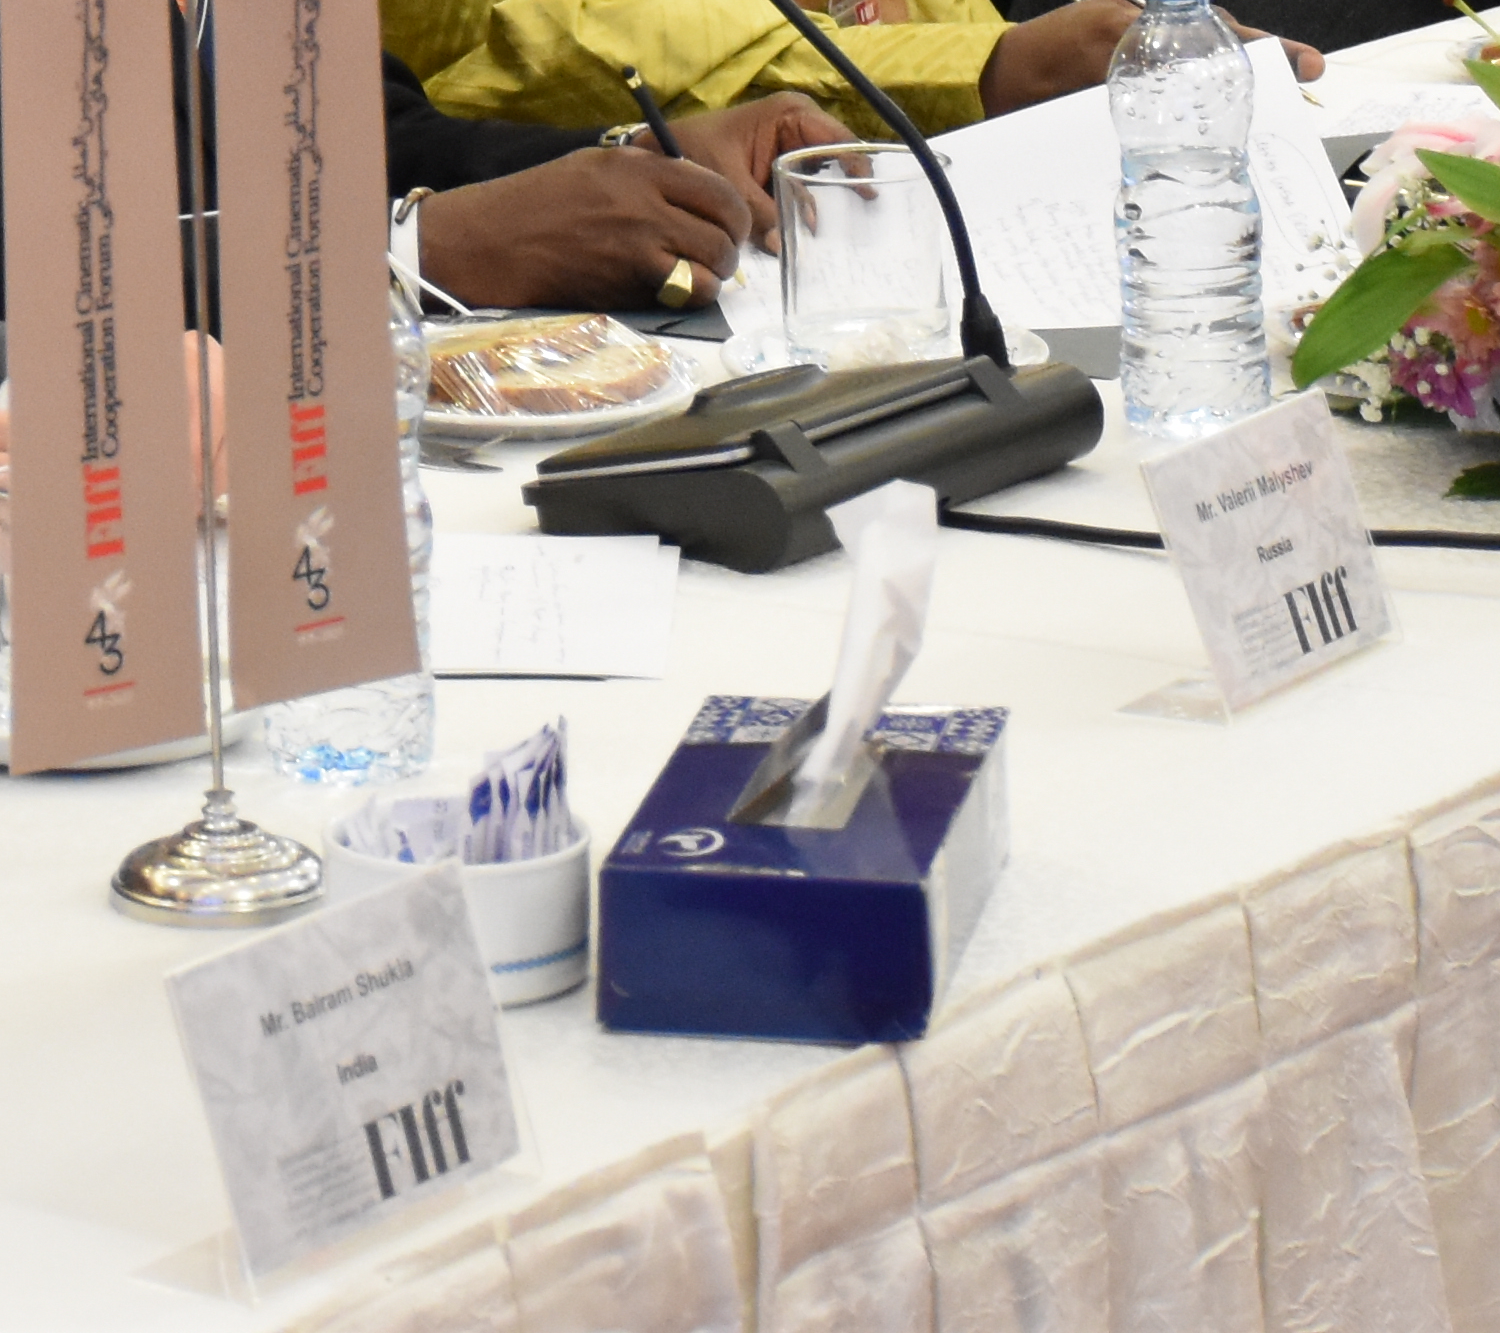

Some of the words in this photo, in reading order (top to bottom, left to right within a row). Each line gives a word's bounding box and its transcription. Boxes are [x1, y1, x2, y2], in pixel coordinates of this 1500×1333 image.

[283, 147, 304, 258] Cinematic
[303, 178, 323, 254] Forum
[72, 200, 97, 315] Cinematic
[92, 234, 116, 311] Forum
[285, 262, 306, 403] International
[304, 259, 328, 397] Cooperation
[73, 319, 100, 463] International
[94, 316, 123, 458] Cooperation
[1196, 500, 1218, 523] Mr.
[1217, 481, 1257, 513] Valerii
[1256, 461, 1313, 497] Malyshev
[1256, 537, 1294, 563] Russia
[260, 1012, 290, 1036] Mr.
[355, 959, 414, 997] Shukla
[336, 1050, 379, 1085] India
